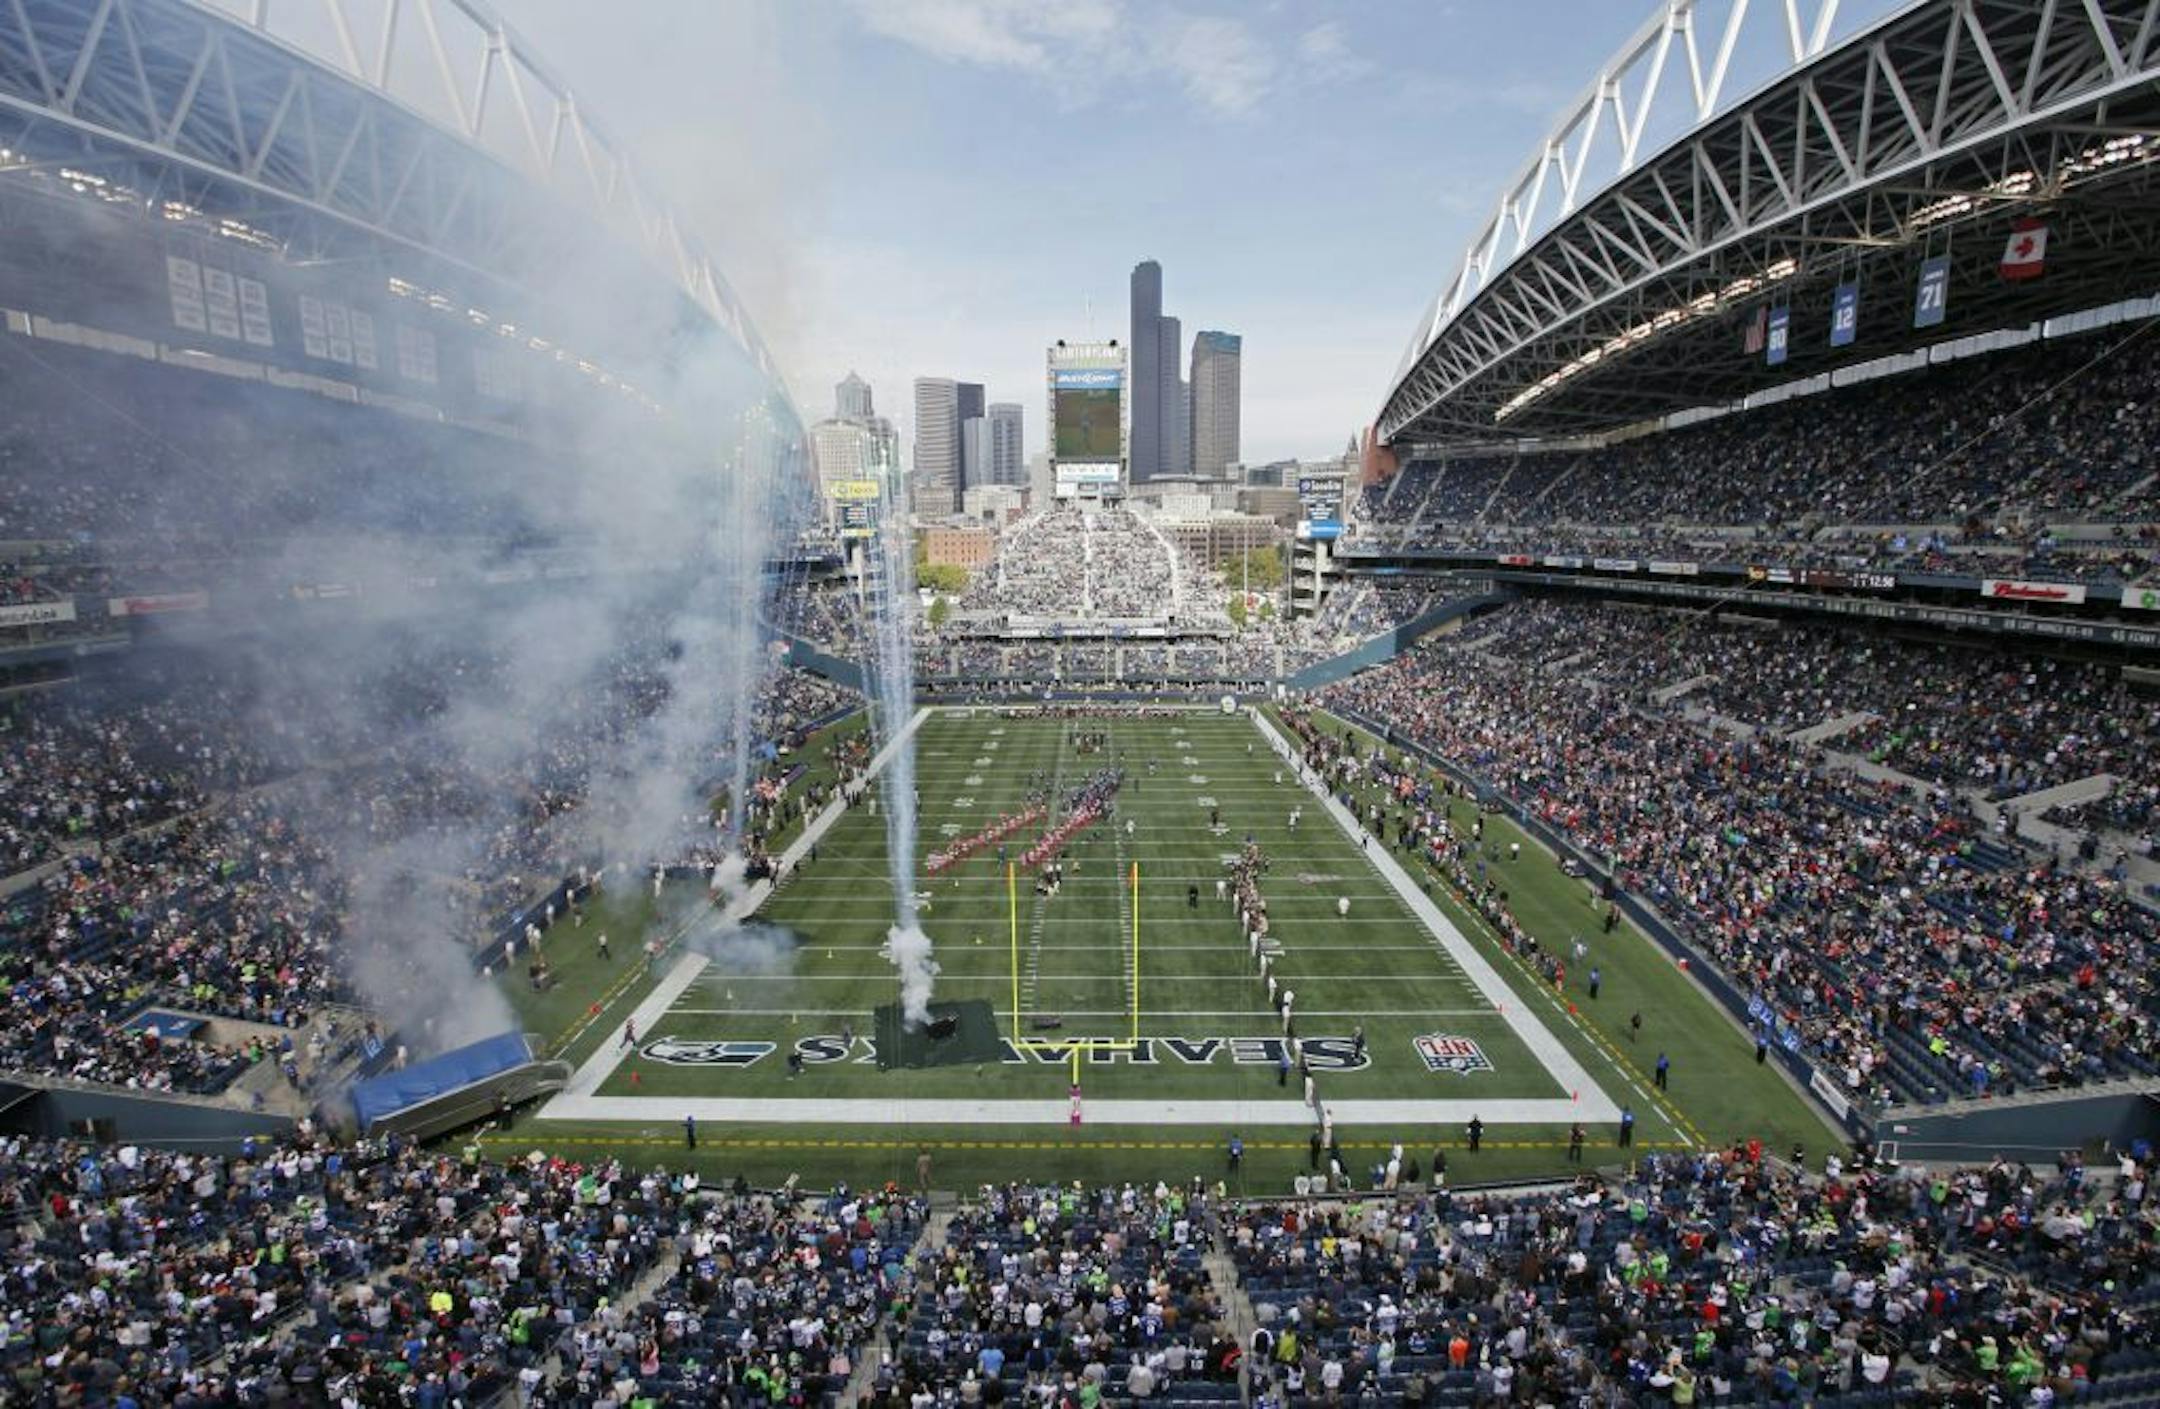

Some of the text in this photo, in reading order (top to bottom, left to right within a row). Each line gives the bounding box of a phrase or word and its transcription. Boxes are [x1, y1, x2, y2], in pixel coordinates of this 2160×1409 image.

[1920, 282, 1942, 312] 71
[1834, 306, 1854, 331] 12
[795, 1035, 1372, 1071] SEAHAS
[1420, 1040, 1475, 1055] NFL
